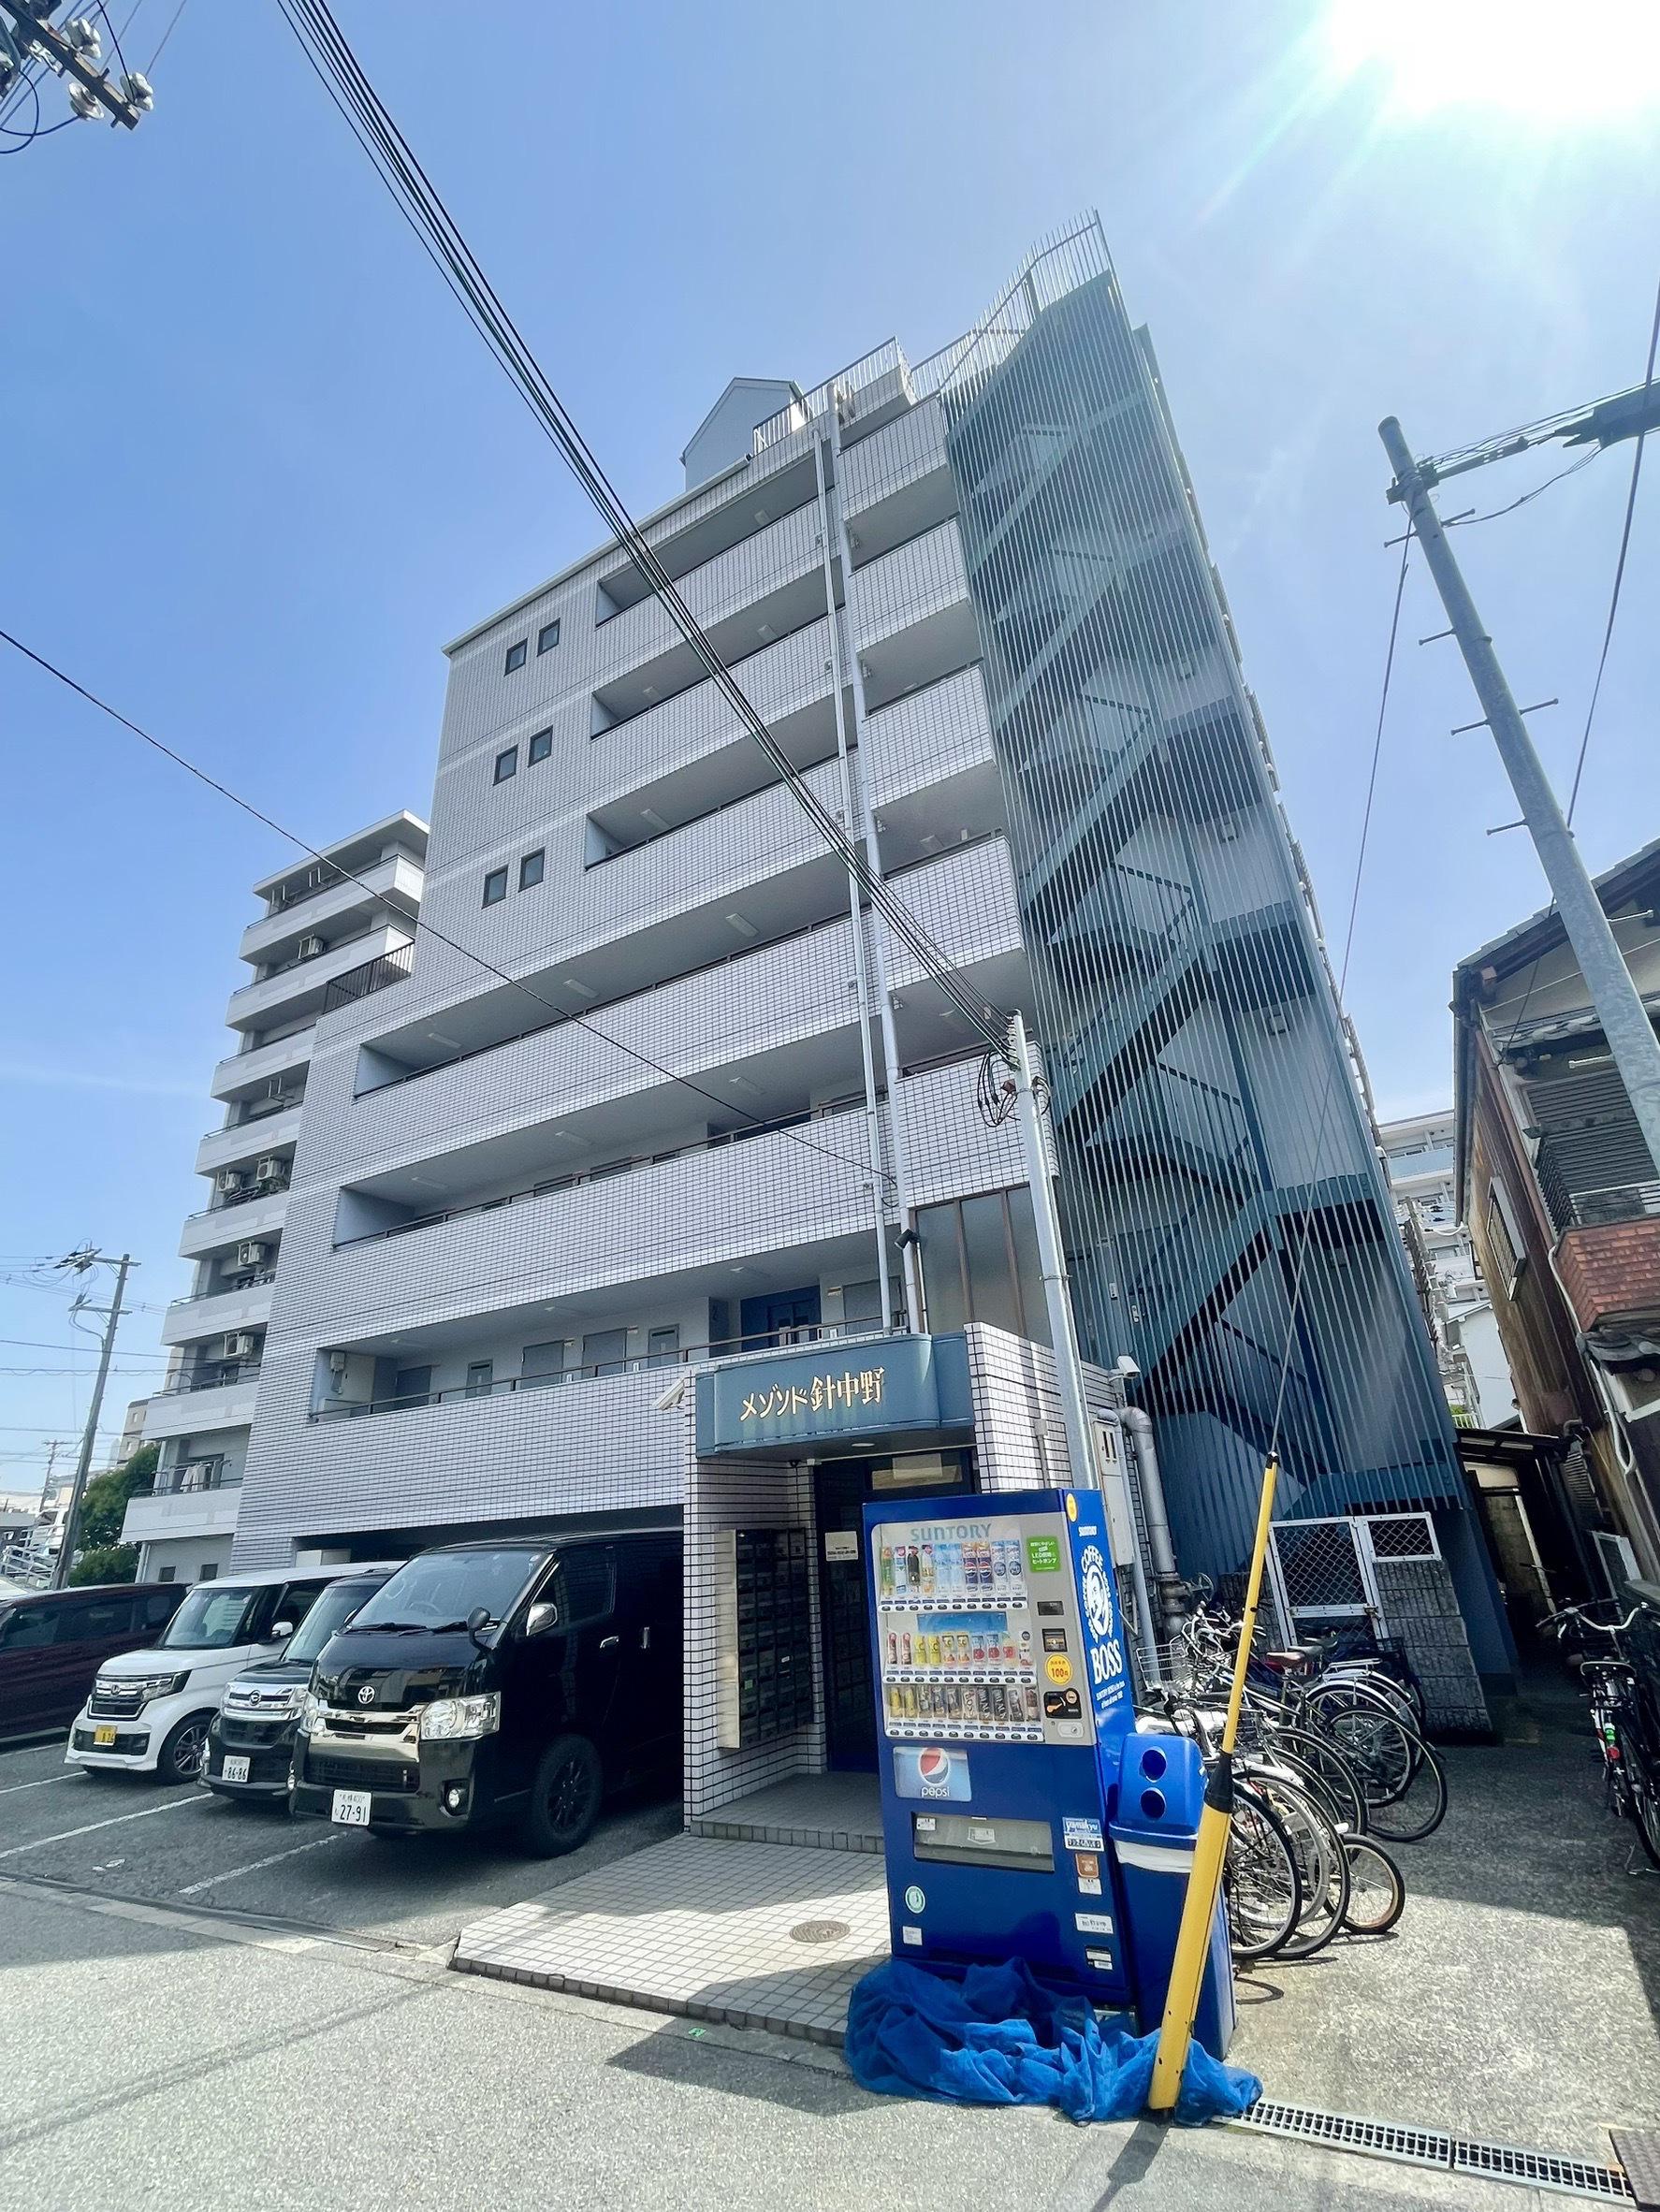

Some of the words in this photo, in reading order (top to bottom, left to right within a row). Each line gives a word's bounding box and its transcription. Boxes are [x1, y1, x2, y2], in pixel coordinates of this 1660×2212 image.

[910, 1523, 992, 1542] SUNTORY
[1089, 1638, 1123, 1685] BOSS
[921, 1786, 950, 1798] pepsi
[340, 1804, 367, 1823] 27-91
